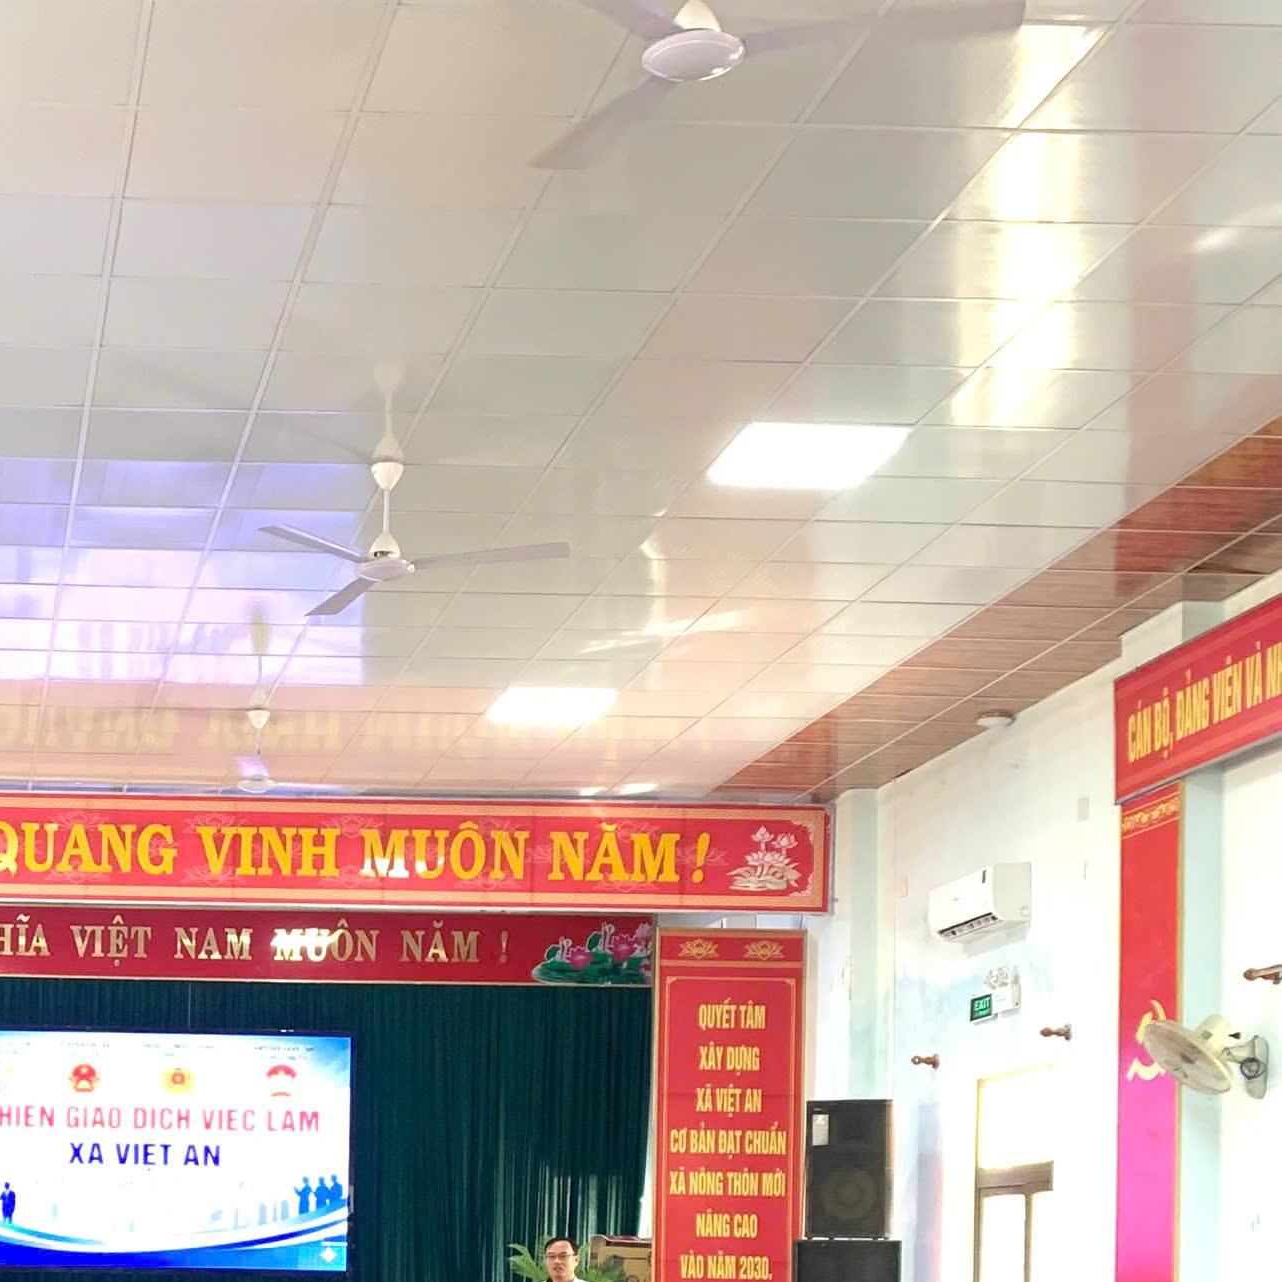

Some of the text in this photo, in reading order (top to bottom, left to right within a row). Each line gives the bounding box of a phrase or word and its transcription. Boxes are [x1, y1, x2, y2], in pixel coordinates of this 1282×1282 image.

[196, 826, 342, 877] VINH
[360, 821, 530, 881] MUÔN
[70, 915, 152, 967] VIỆT
[174, 927, 253, 960] NAM
[272, 918, 379, 962] MUÔN
[400, 920, 480, 963] NĂM
[698, 997, 766, 1031] QUYẾT TÂM
[699, 1041, 760, 1076] XÂY DỰNG
[66, 1106, 121, 1129] GIAO
[695, 1083, 762, 1118] XÃ VIỆT AN
[183, 1144, 220, 1166] AN
[670, 1120, 787, 1160] CƠ BẢN ĐẠT CHUẨN
[669, 1166, 785, 1197] XÃ NÔNG THÔN MỚI
[696, 1208, 758, 1238] NÂNG CAO
[680, 1249, 773, 1280] VÀO NĂM 2030.
